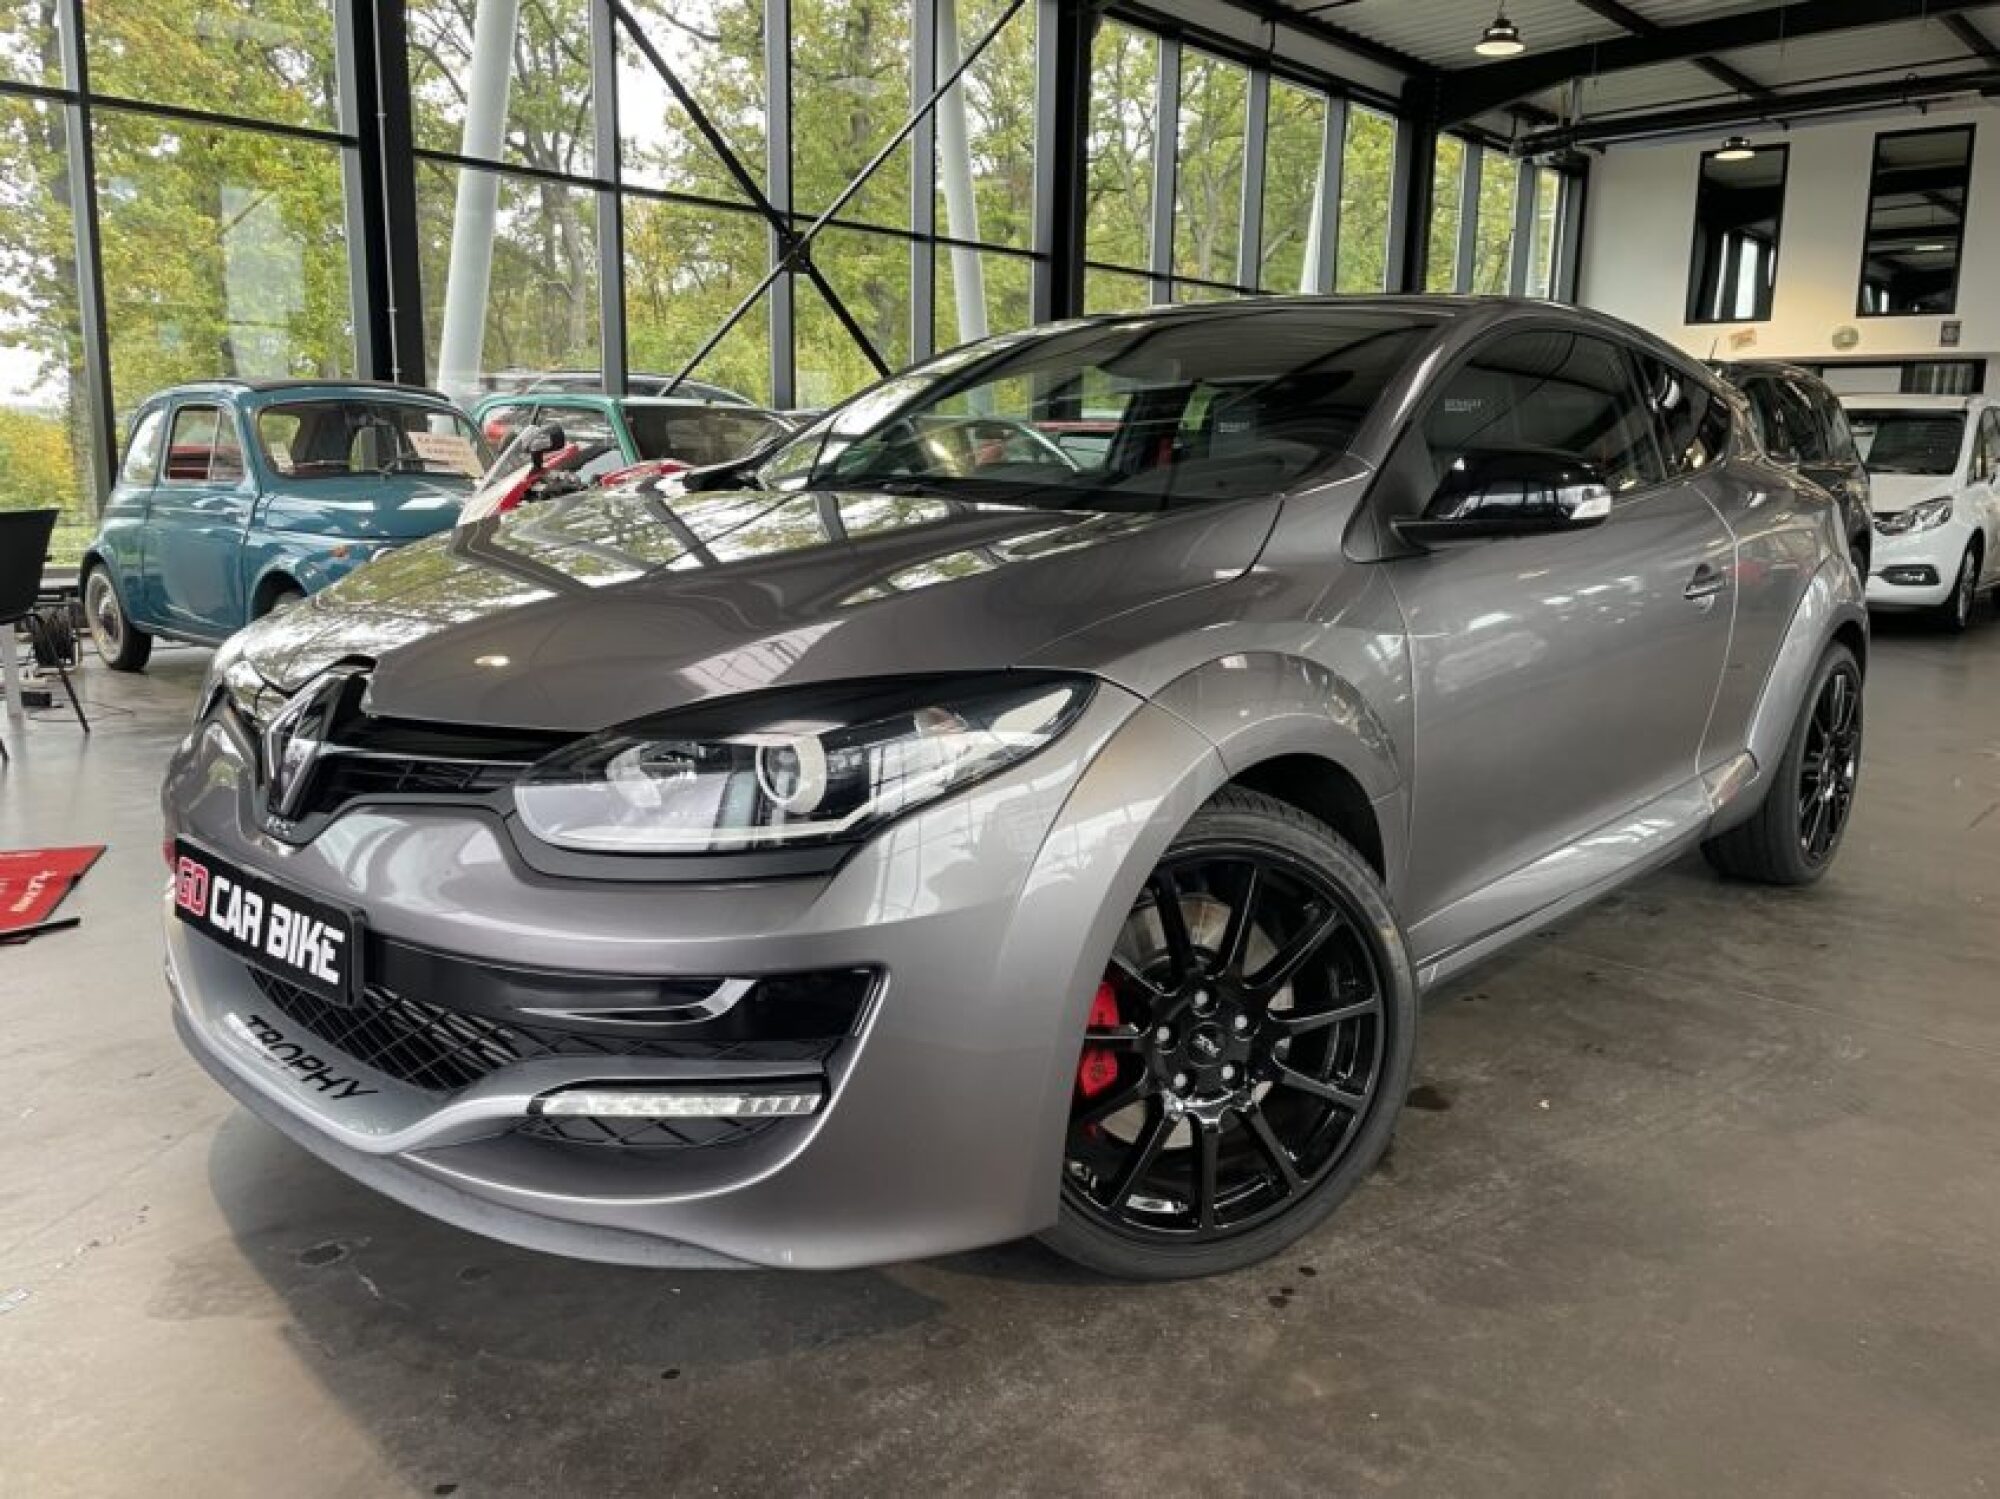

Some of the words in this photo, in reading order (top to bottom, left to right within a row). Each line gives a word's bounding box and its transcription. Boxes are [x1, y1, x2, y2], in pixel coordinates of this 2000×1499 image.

[176, 856, 208, 917] GO
[210, 875, 263, 947] CAR
[267, 903, 345, 985] BIKE
[248, 1014, 378, 1099] TROPHY
